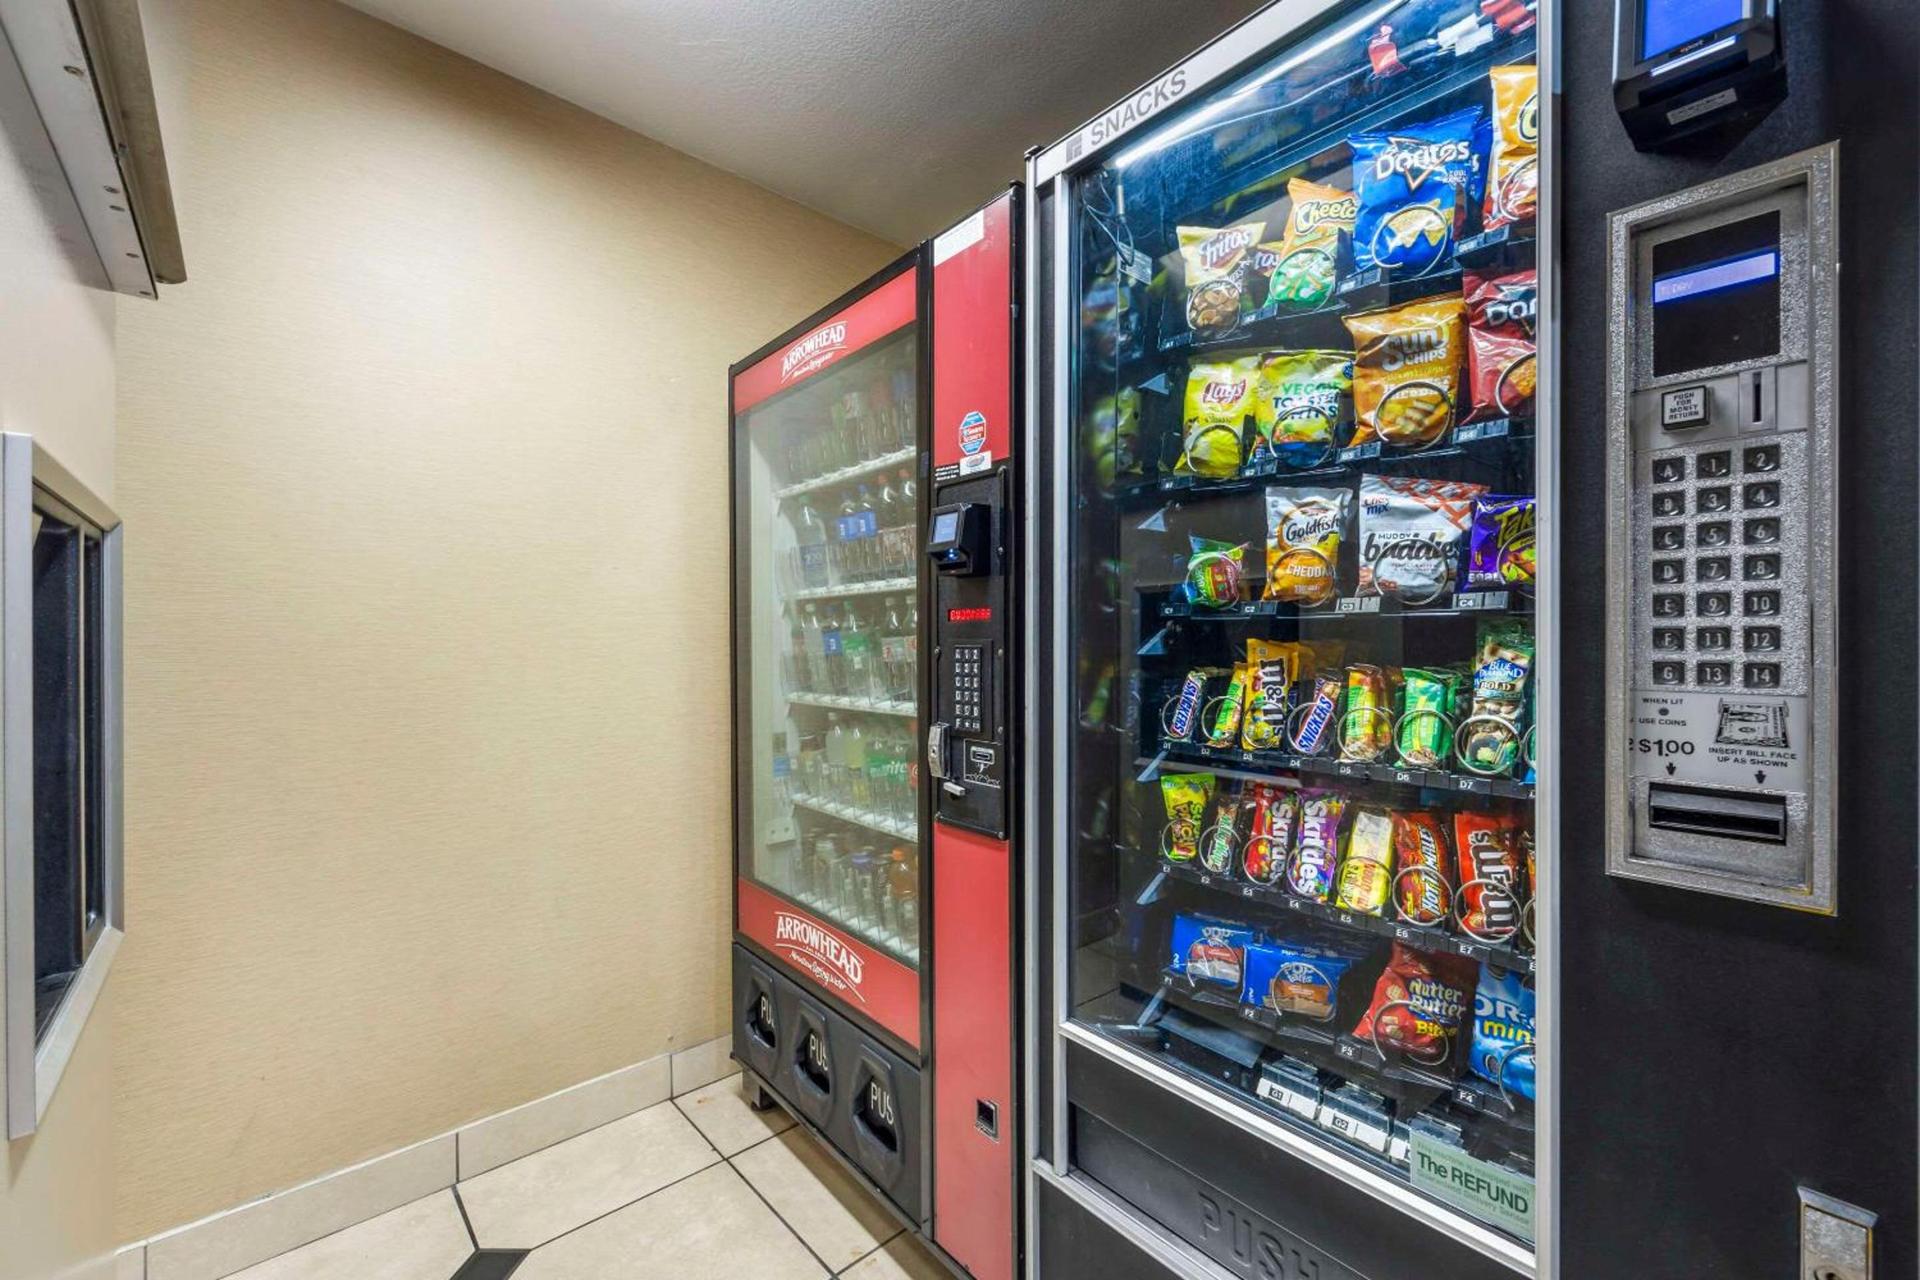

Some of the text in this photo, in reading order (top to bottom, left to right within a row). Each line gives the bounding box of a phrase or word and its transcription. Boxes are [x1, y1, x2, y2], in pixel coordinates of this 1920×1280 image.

[1091, 70, 1186, 146] SNACKS
[1297, 201, 1357, 230] Cheeto
[782, 325, 846, 378] ARROWHEAD
[1674, 392, 1694, 400] PUSH
[1669, 411, 1699, 420] RETURN
[1670, 405, 1698, 413] MONEY
[1664, 453, 1766, 478] A 1 2
[1664, 489, 1766, 512] B 3 4
[1286, 513, 1341, 542] Goldfish
[1664, 523, 1766, 546] C 5 6
[1664, 560, 1766, 579] D 7 8
[1341, 603, 1354, 611] C3
[1459, 599, 1474, 607] C4
[1664, 596, 1770, 613] E 9 10
[1664, 632, 1770, 647] F 11 12
[1664, 667, 1770, 683] G 13 14
[1174, 679, 1197, 735] SNICKERS
[1298, 696, 1333, 752] SNICKERS
[1658, 718, 1687, 726] COINS
[1639, 738, 1695, 757] $1.00
[1709, 747, 1742, 756] INSERT
[1770, 752, 1797, 760] FACE
[1733, 757, 1747, 765] AS
[1750, 759, 1788, 768] SHOWN
[1397, 773, 1409, 781] D6
[1460, 780, 1474, 789] D7
[1421, 885, 1440, 915] HOT
[1396, 929, 1409, 938] E6
[776, 916, 861, 984] ARROWHEAD
[1460, 945, 1473, 954] E7
[1409, 978, 1462, 1002] Nutter
[1409, 994, 1467, 1019] Butter
[871, 1082, 894, 1125] PUS
[1417, 1151, 1448, 1178] The
[1452, 1166, 1529, 1214] REFUND
[1199, 1191, 1320, 1280] PUSH
